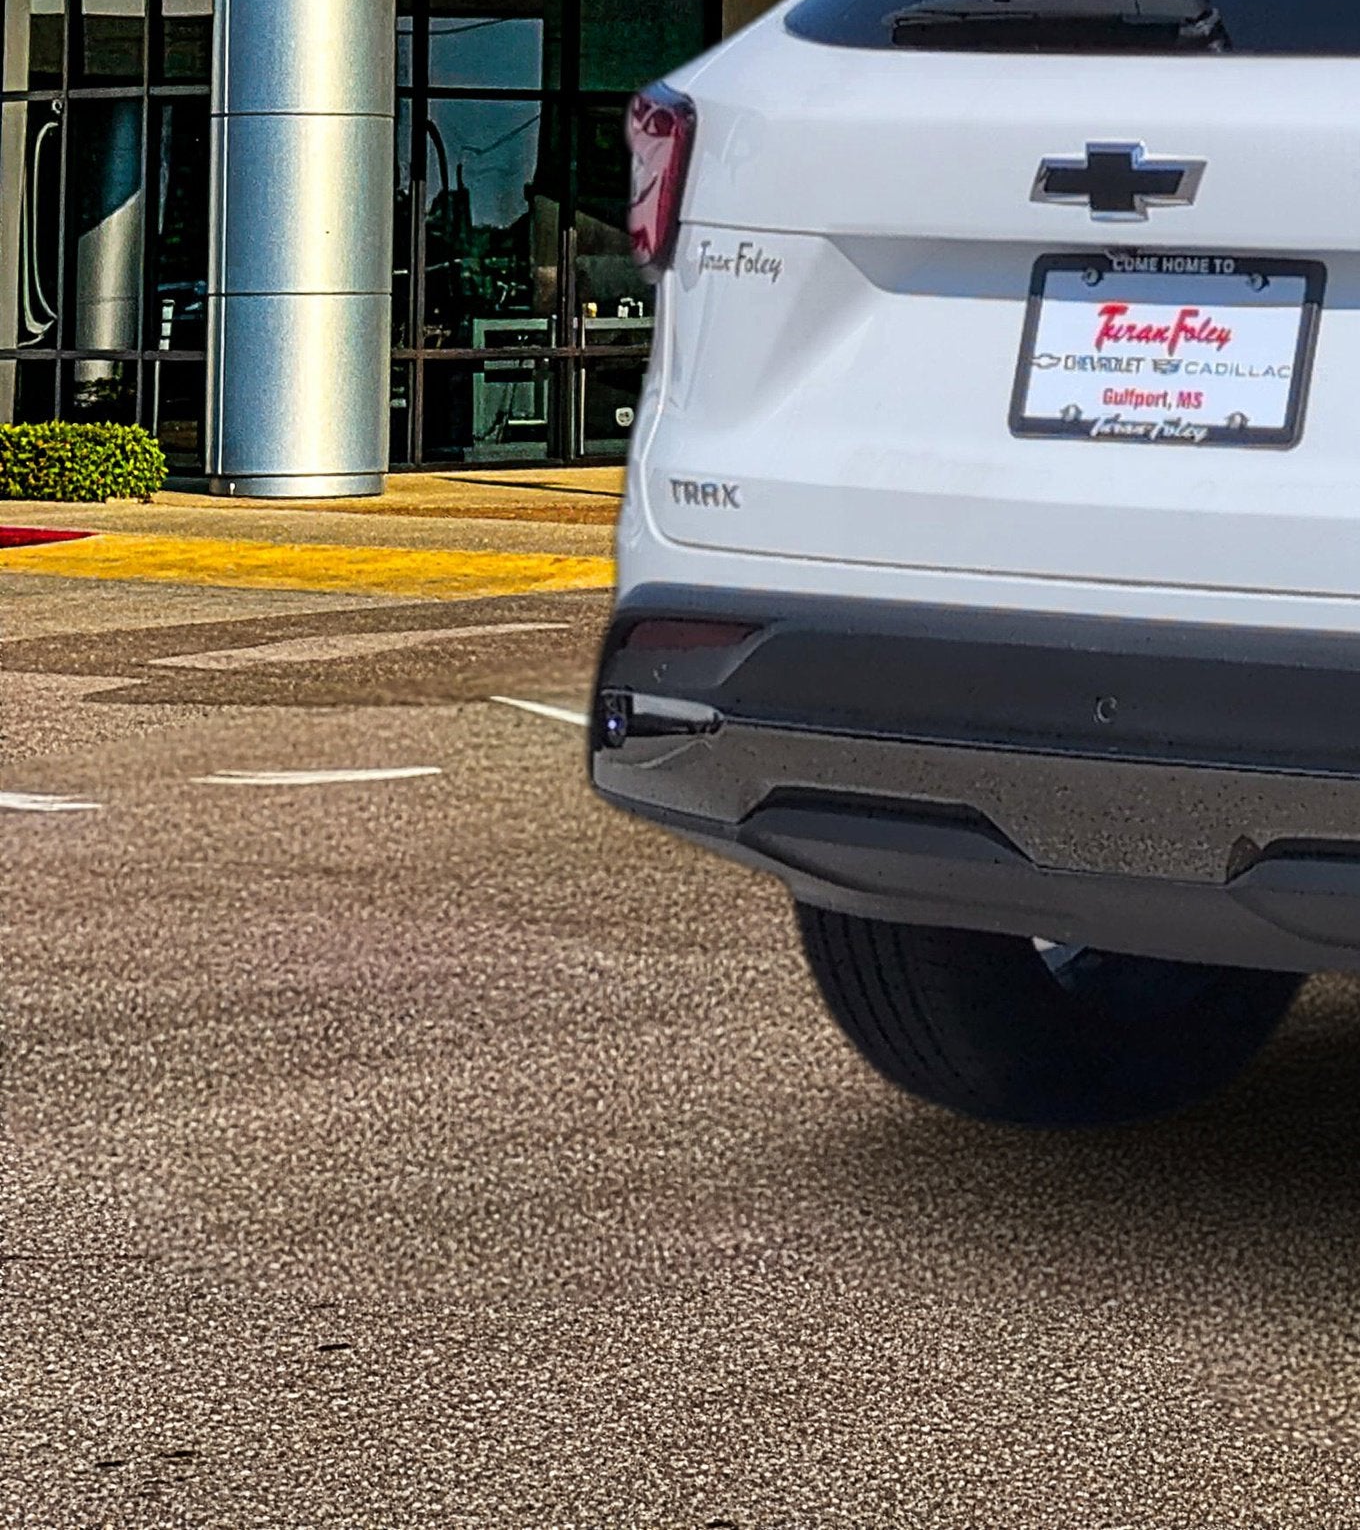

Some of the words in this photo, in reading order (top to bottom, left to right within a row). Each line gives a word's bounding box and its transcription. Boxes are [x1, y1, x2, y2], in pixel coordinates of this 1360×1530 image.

[734, 241, 783, 284] Foley
[1111, 256, 1159, 272] COME
[1162, 257, 1210, 273] HOME
[1212, 258, 1236, 274] TO
[1167, 308, 1233, 358] Foley
[1063, 354, 1146, 375] CHEVROLET
[1184, 361, 1292, 379] CADILLAC
[1102, 387, 1173, 410] Gulfport,
[1177, 391, 1204, 410] MS
[669, 478, 741, 510] TRAX
